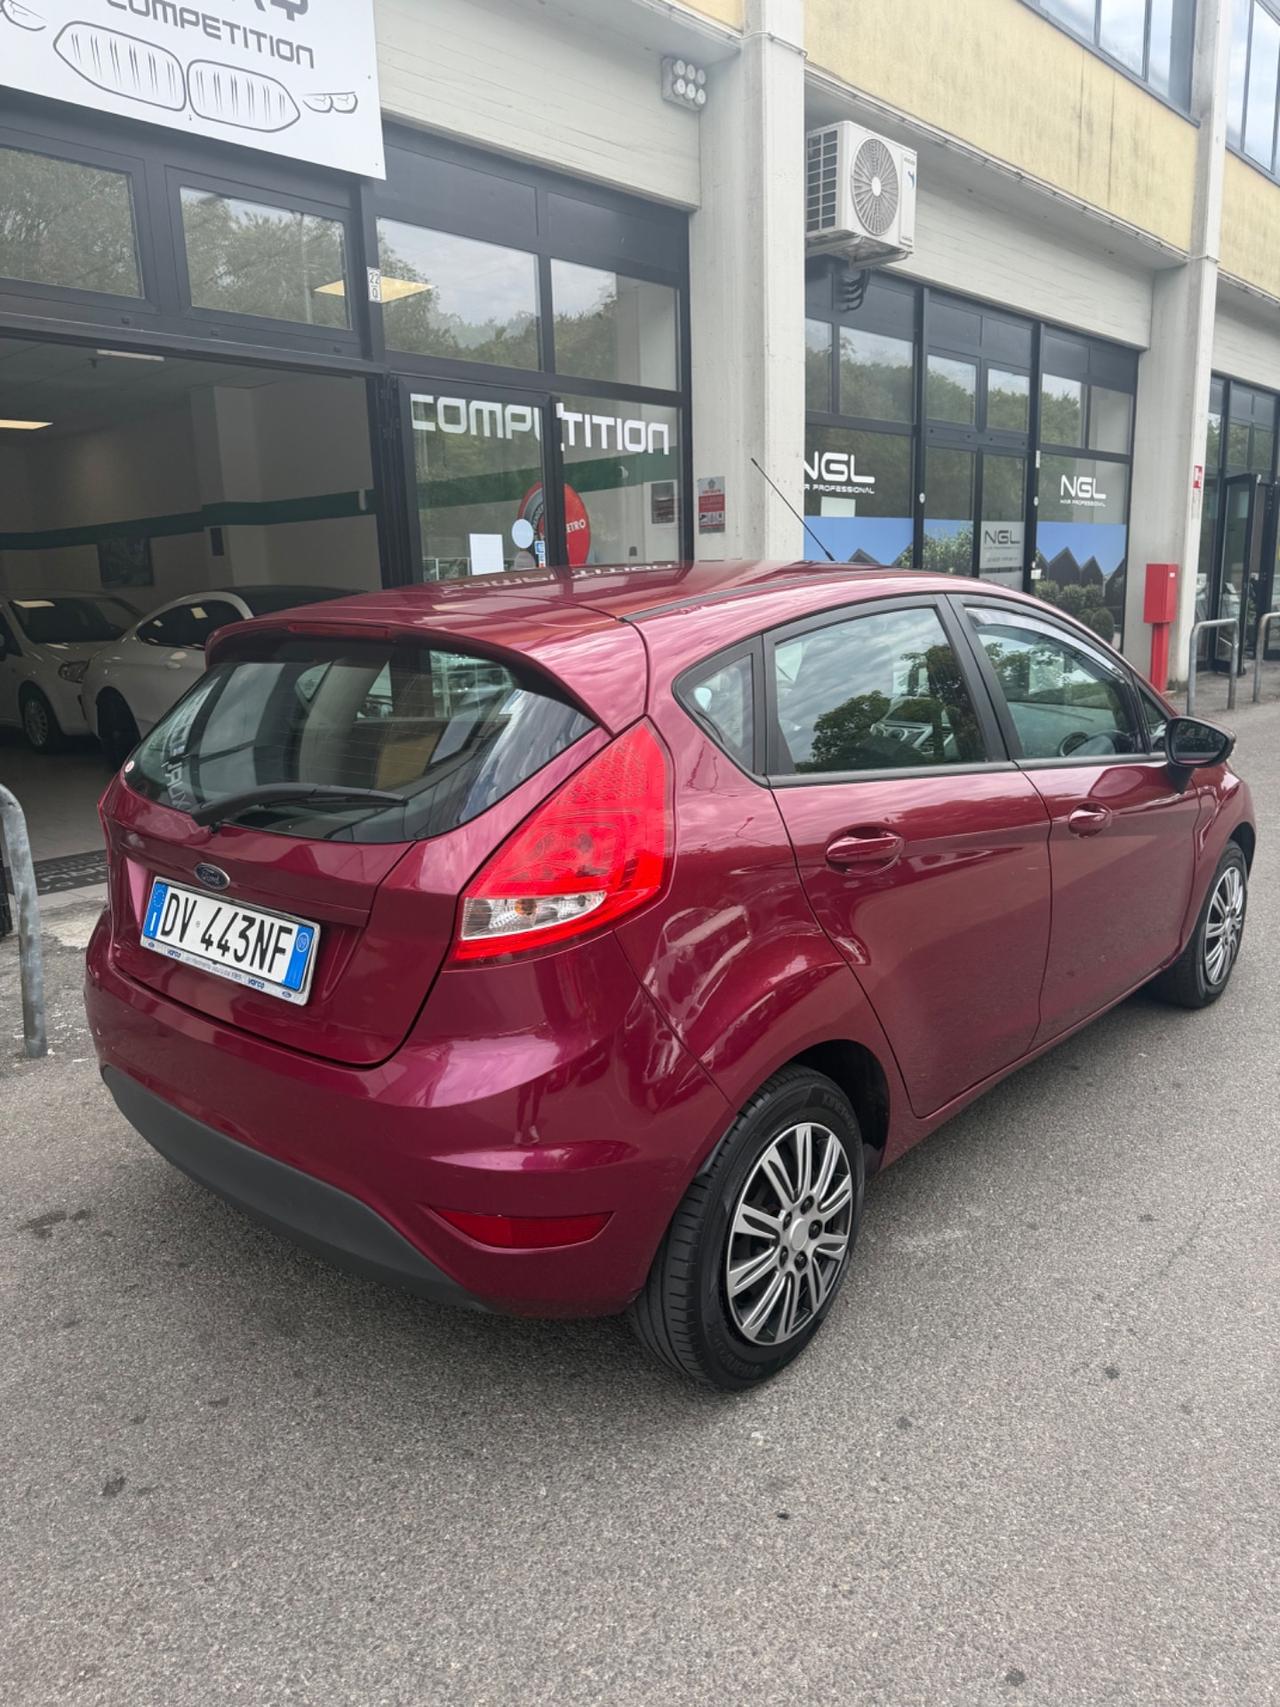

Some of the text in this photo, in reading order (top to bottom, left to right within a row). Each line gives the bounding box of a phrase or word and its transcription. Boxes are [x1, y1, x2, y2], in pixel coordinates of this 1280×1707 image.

[812, 483, 875, 494] PROFESSIONAL
[1060, 474, 1106, 499] NGL
[566, 519, 586, 533] ETRO
[984, 529, 1021, 545] NGL
[160, 892, 293, 974] DV 443NF
